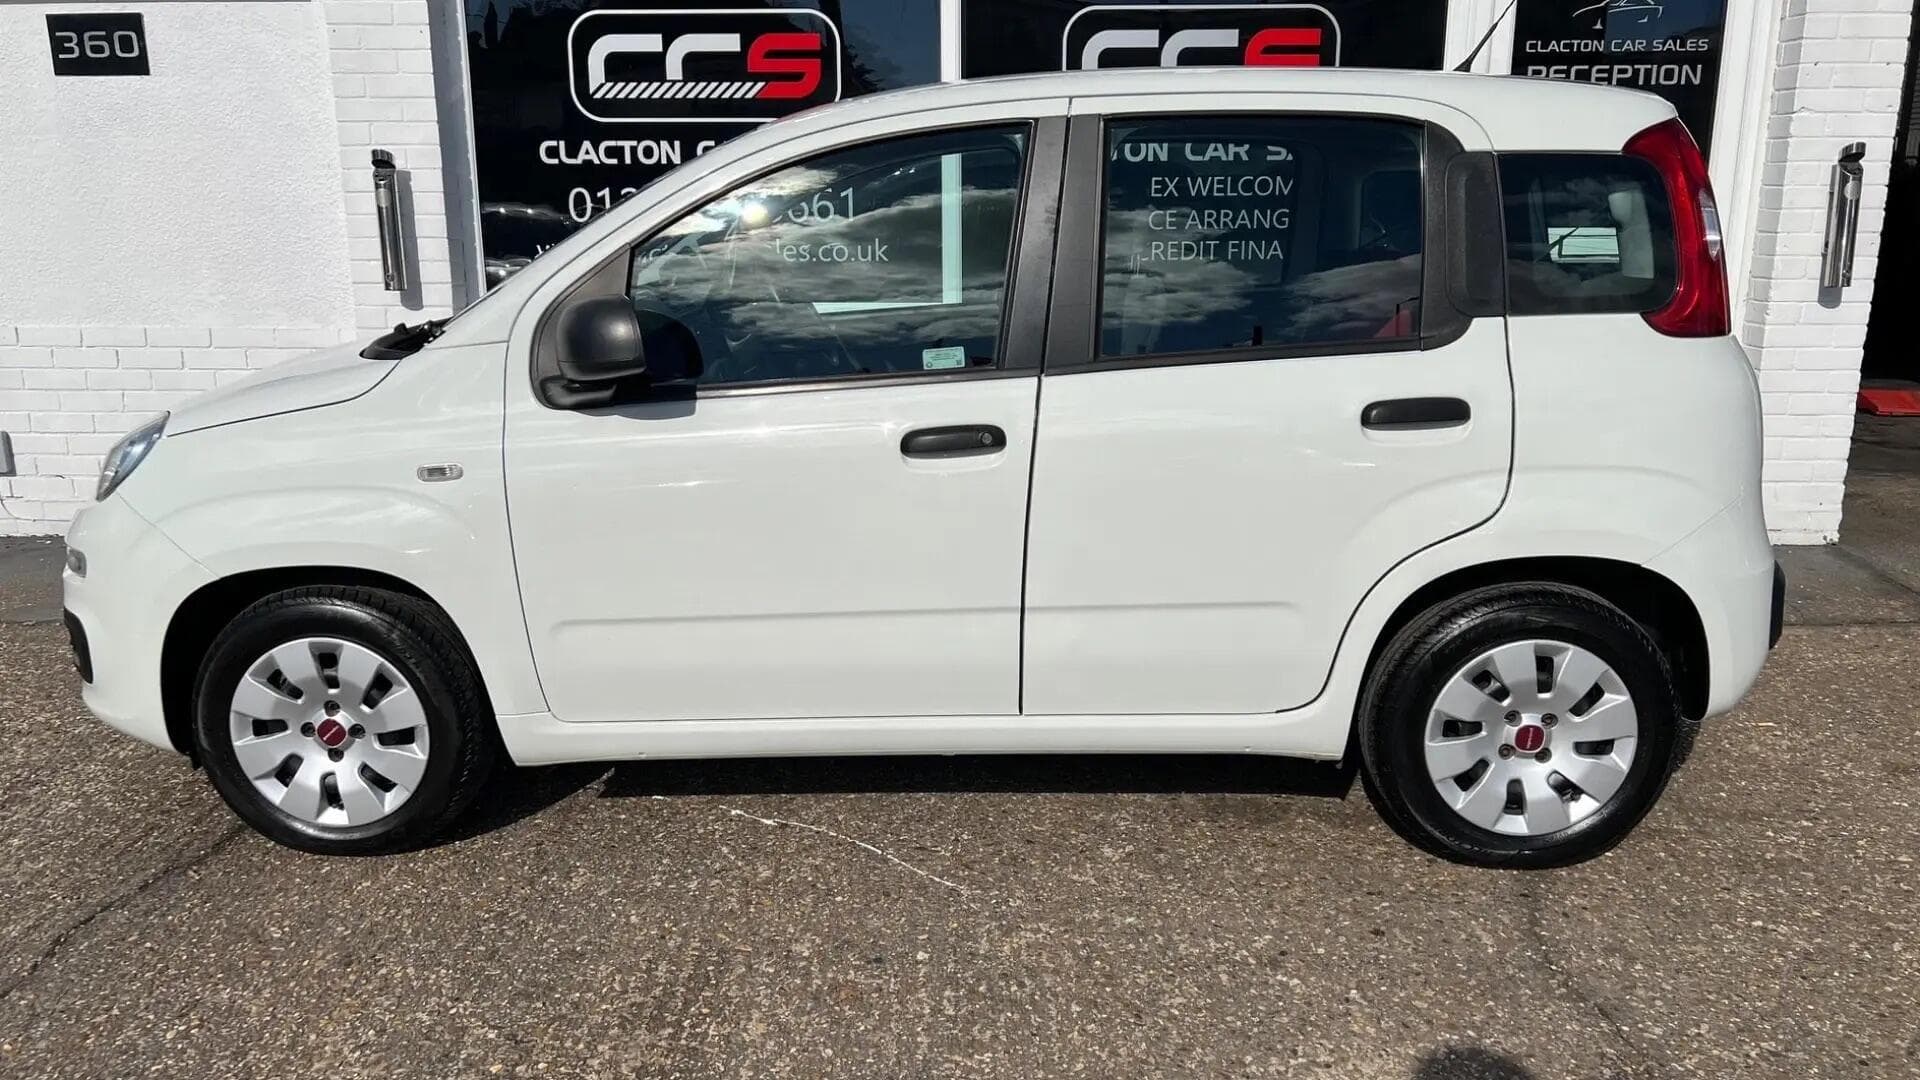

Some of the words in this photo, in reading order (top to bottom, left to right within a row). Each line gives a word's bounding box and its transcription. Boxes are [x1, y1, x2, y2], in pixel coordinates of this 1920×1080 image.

[55, 31, 140, 58] 360
[1526, 40, 1604, 52] CLACTON
[1611, 39, 1646, 51] CAR
[1652, 39, 1709, 51] SALES
[588, 33, 821, 99] CCS
[539, 140, 681, 164] CLACTON
[1112, 143, 1168, 162] ON
[1151, 177, 1179, 197] EX
[1150, 210, 1177, 230] CE
[1185, 208, 1290, 230] ARRANG
[1141, 241, 1220, 261] REDIT
[1228, 240, 1283, 260] FINA
